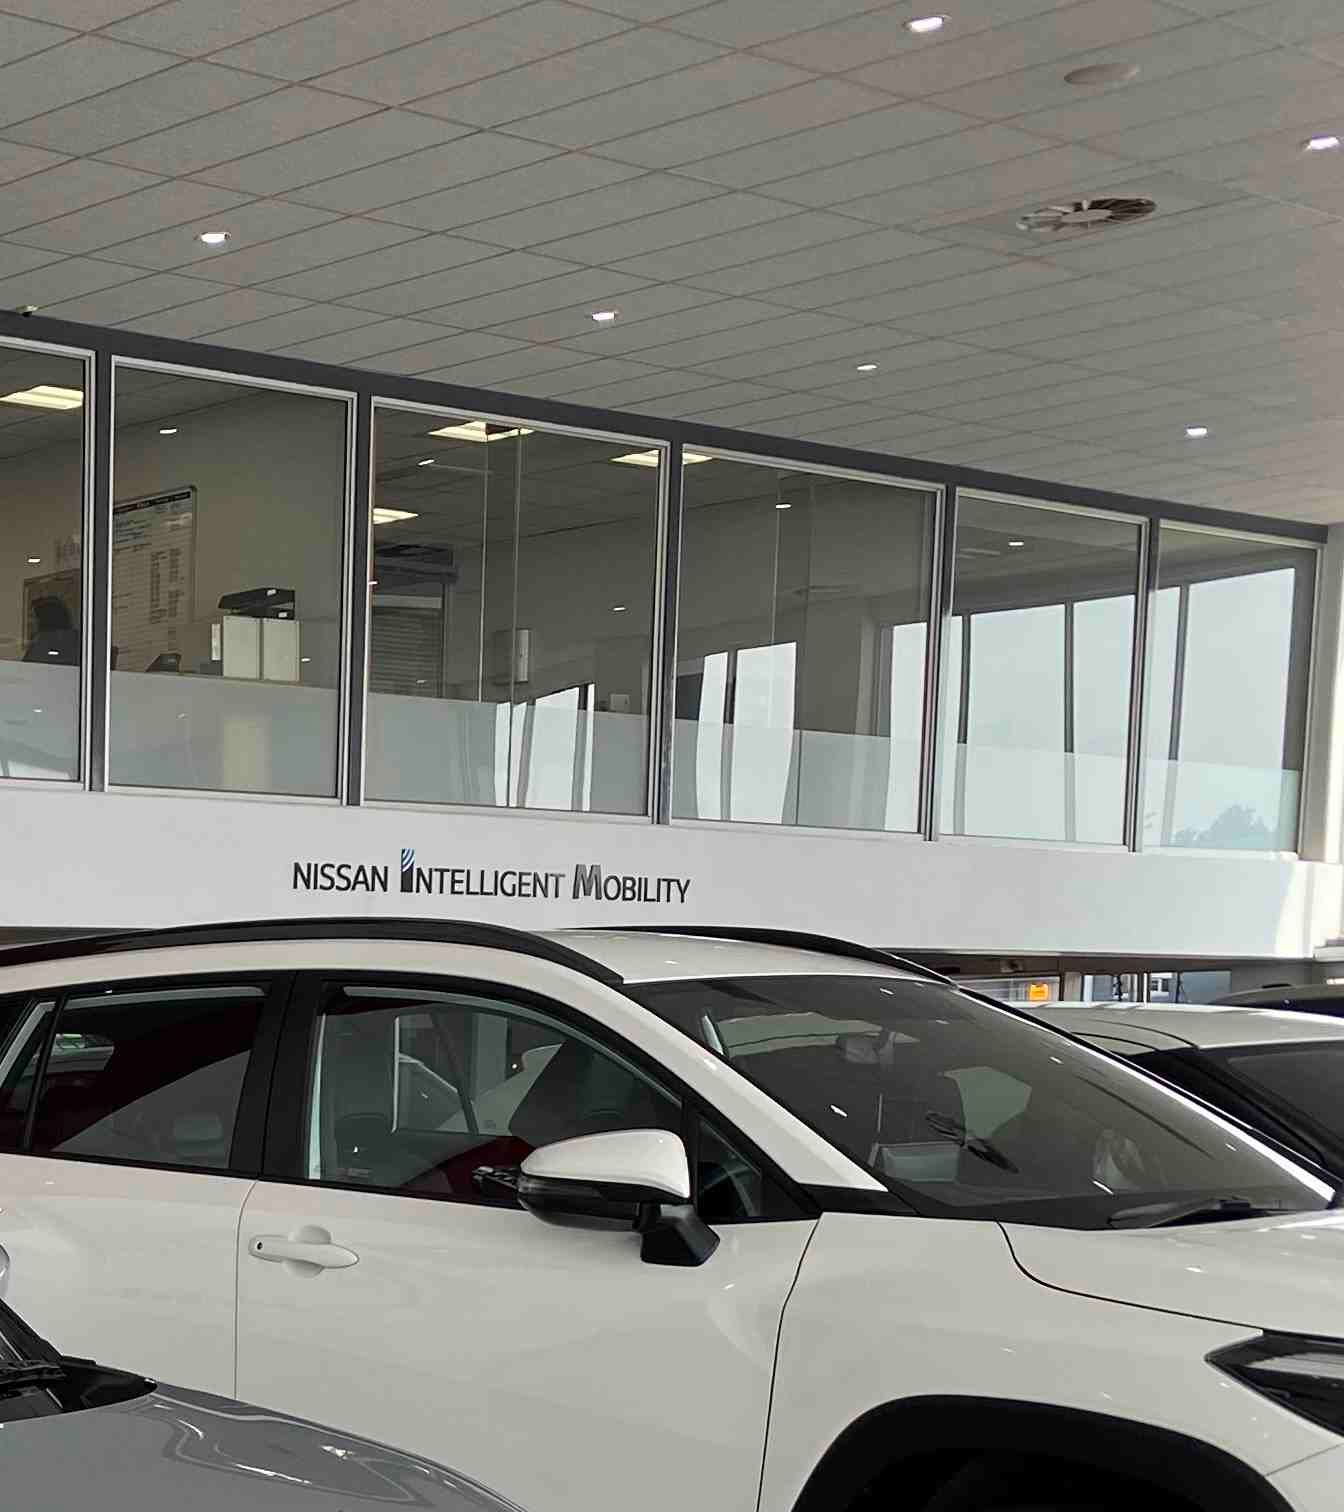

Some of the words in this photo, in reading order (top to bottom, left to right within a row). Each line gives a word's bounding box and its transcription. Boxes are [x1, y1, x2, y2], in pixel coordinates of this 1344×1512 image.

[291, 862, 389, 893] NISSAN
[400, 848, 566, 899] INTELLIGENT
[572, 864, 692, 904] MOBILITY
